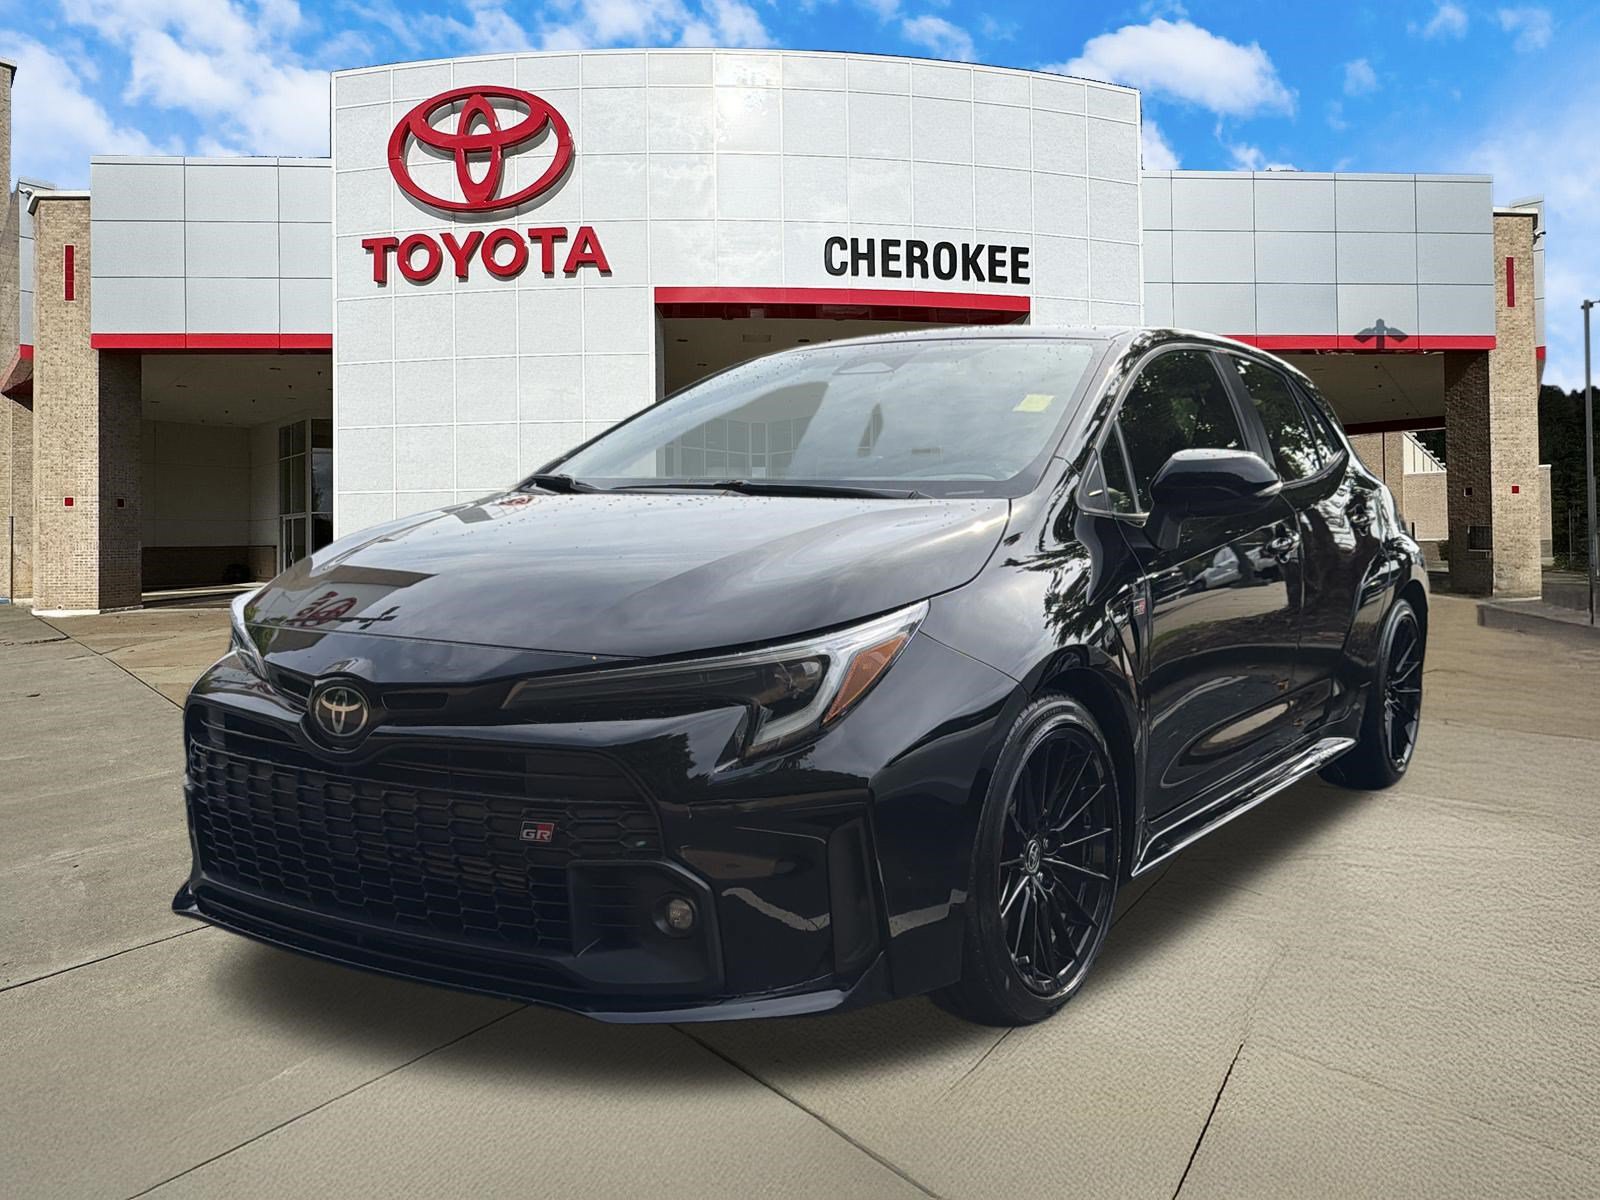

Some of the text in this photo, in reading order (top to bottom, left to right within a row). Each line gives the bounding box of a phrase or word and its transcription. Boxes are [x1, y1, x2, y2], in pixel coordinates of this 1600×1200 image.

[362, 226, 612, 286] TOYOTA
[824, 236, 1031, 285] CHEROKEE
[521, 828, 551, 841] GR
